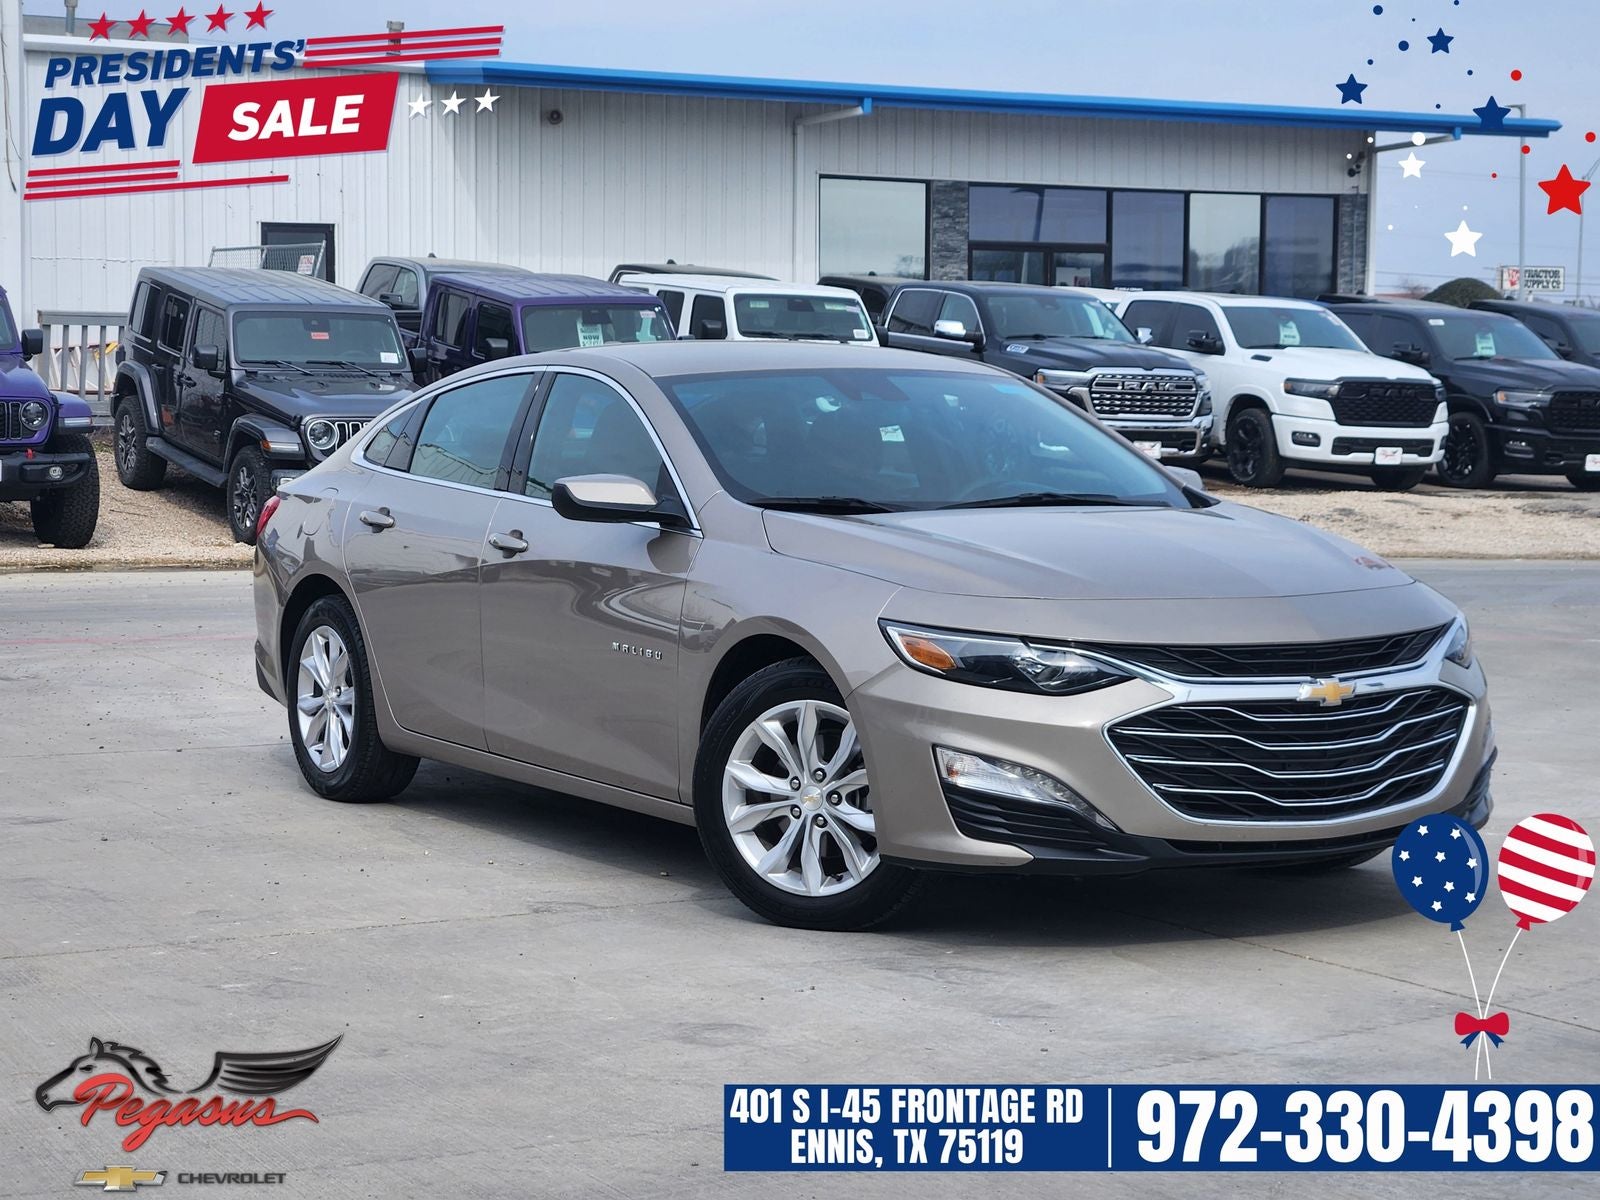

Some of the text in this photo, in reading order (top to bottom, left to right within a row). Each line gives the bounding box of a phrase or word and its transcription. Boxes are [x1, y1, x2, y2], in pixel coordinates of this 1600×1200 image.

[1524, 269, 1561, 279] TRACTOR
[1523, 279, 1550, 289] SUPPLY
[583, 333, 600, 341] NOW
[1123, 381, 1176, 392] RAM
[1369, 387, 1416, 398] RAM
[612, 641, 663, 660] MALIBU
